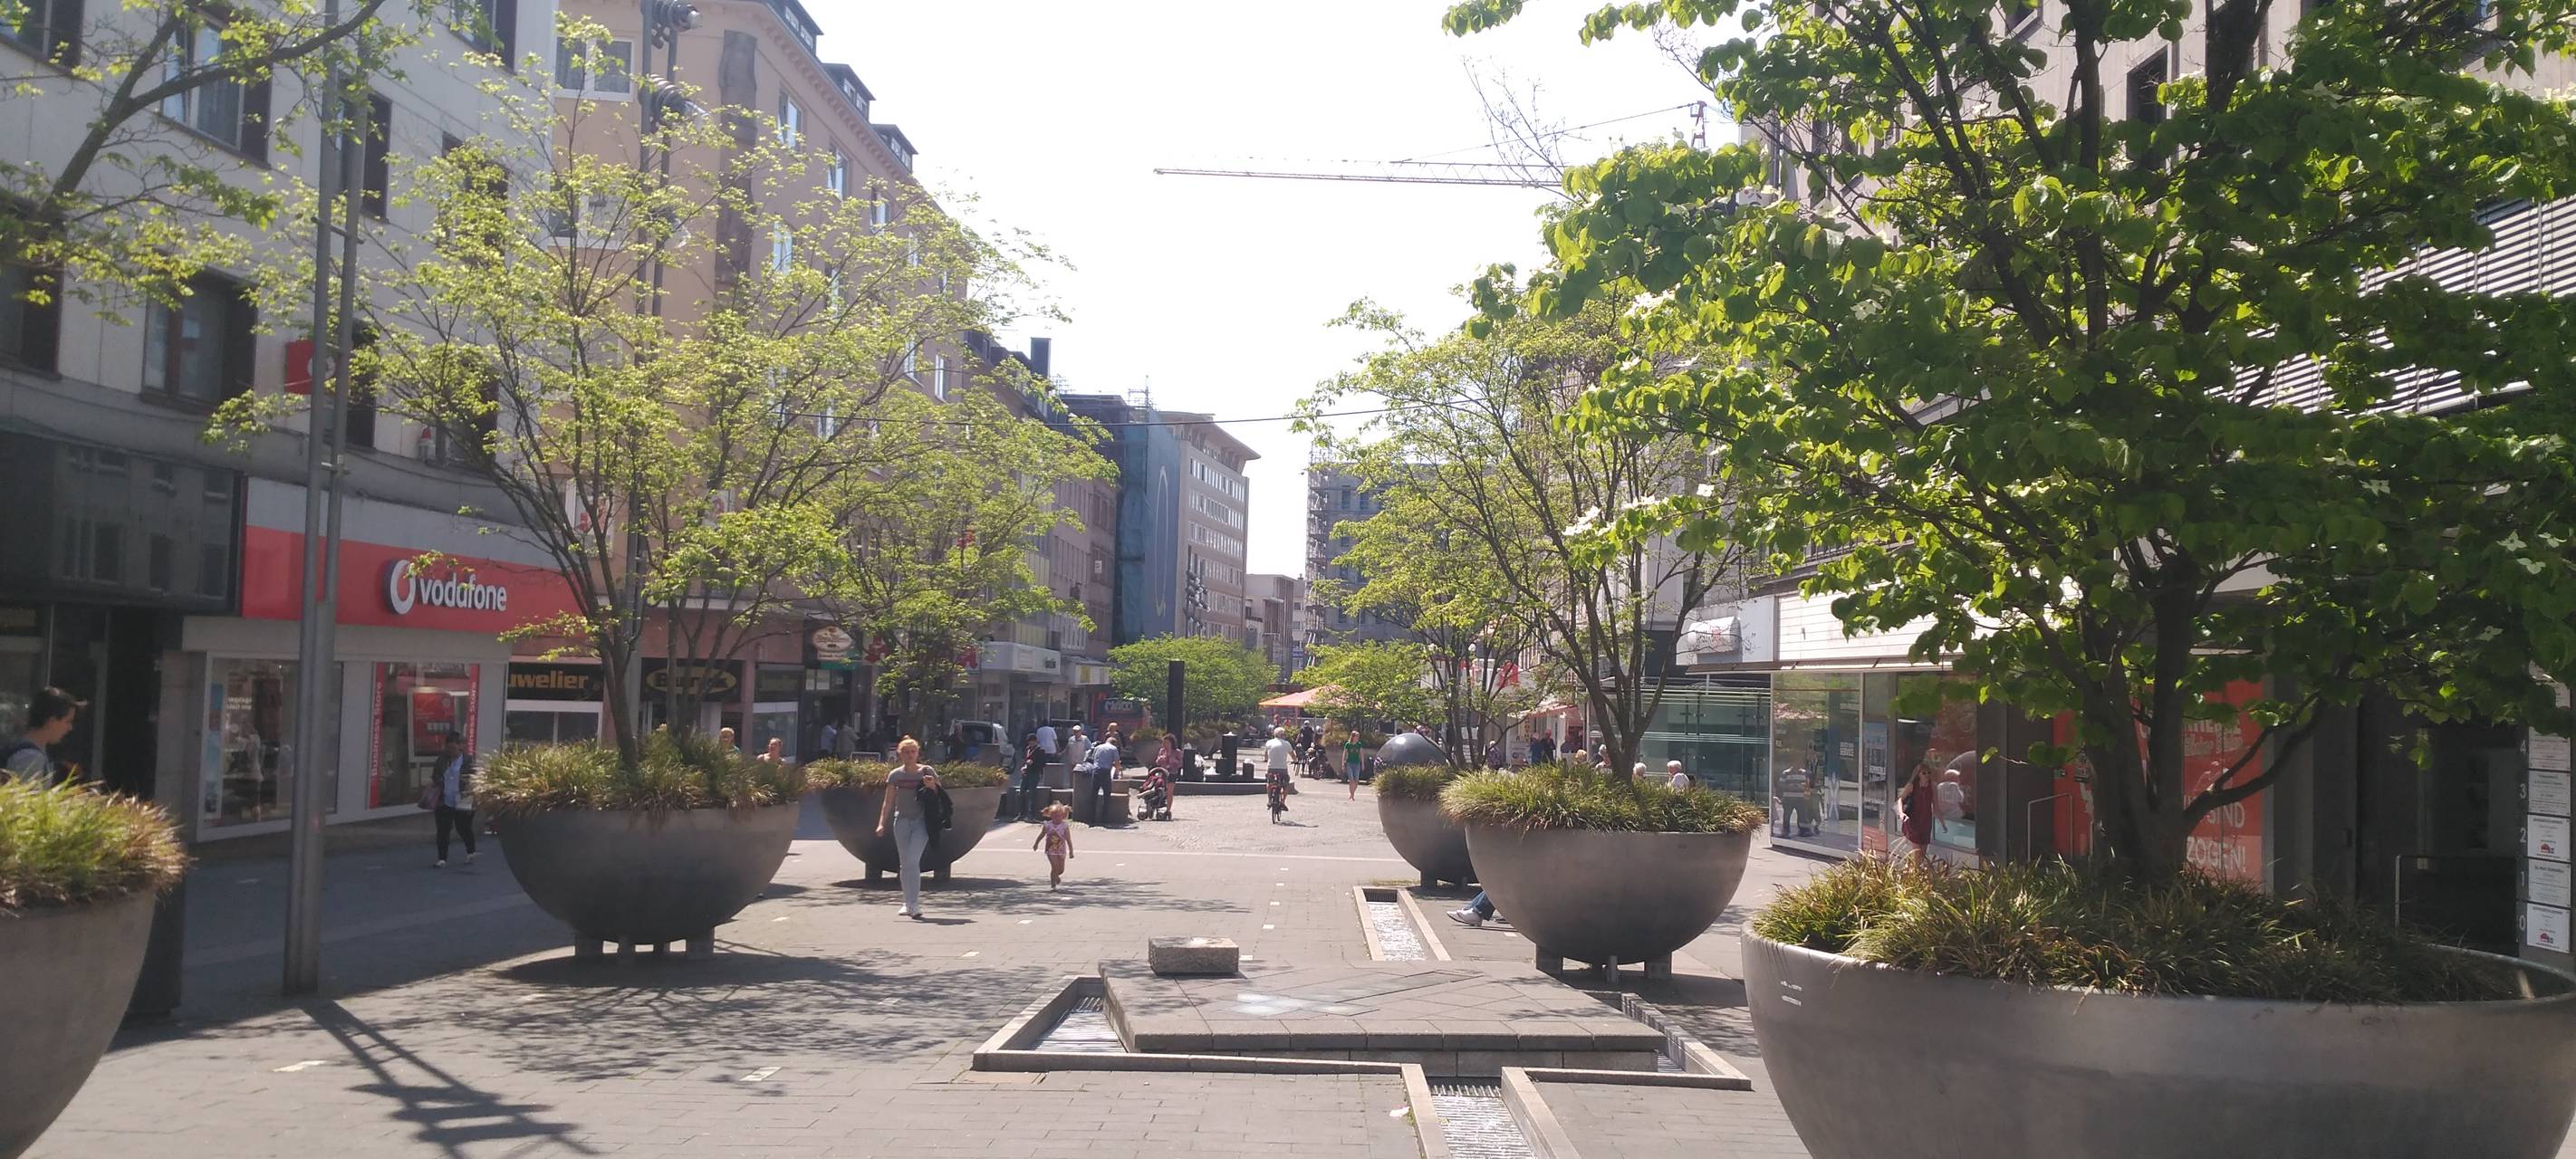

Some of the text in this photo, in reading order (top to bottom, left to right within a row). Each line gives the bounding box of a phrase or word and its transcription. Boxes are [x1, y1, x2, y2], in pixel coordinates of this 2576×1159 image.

[419, 571, 507, 611] vodafone
[371, 682, 382, 776] Business Store
[2520, 740, 2526, 753] 4
[2520, 783, 2527, 799] 3
[2520, 828, 2526, 843] 2
[2521, 871, 2525, 886] 1
[2519, 915, 2526, 931] 0
